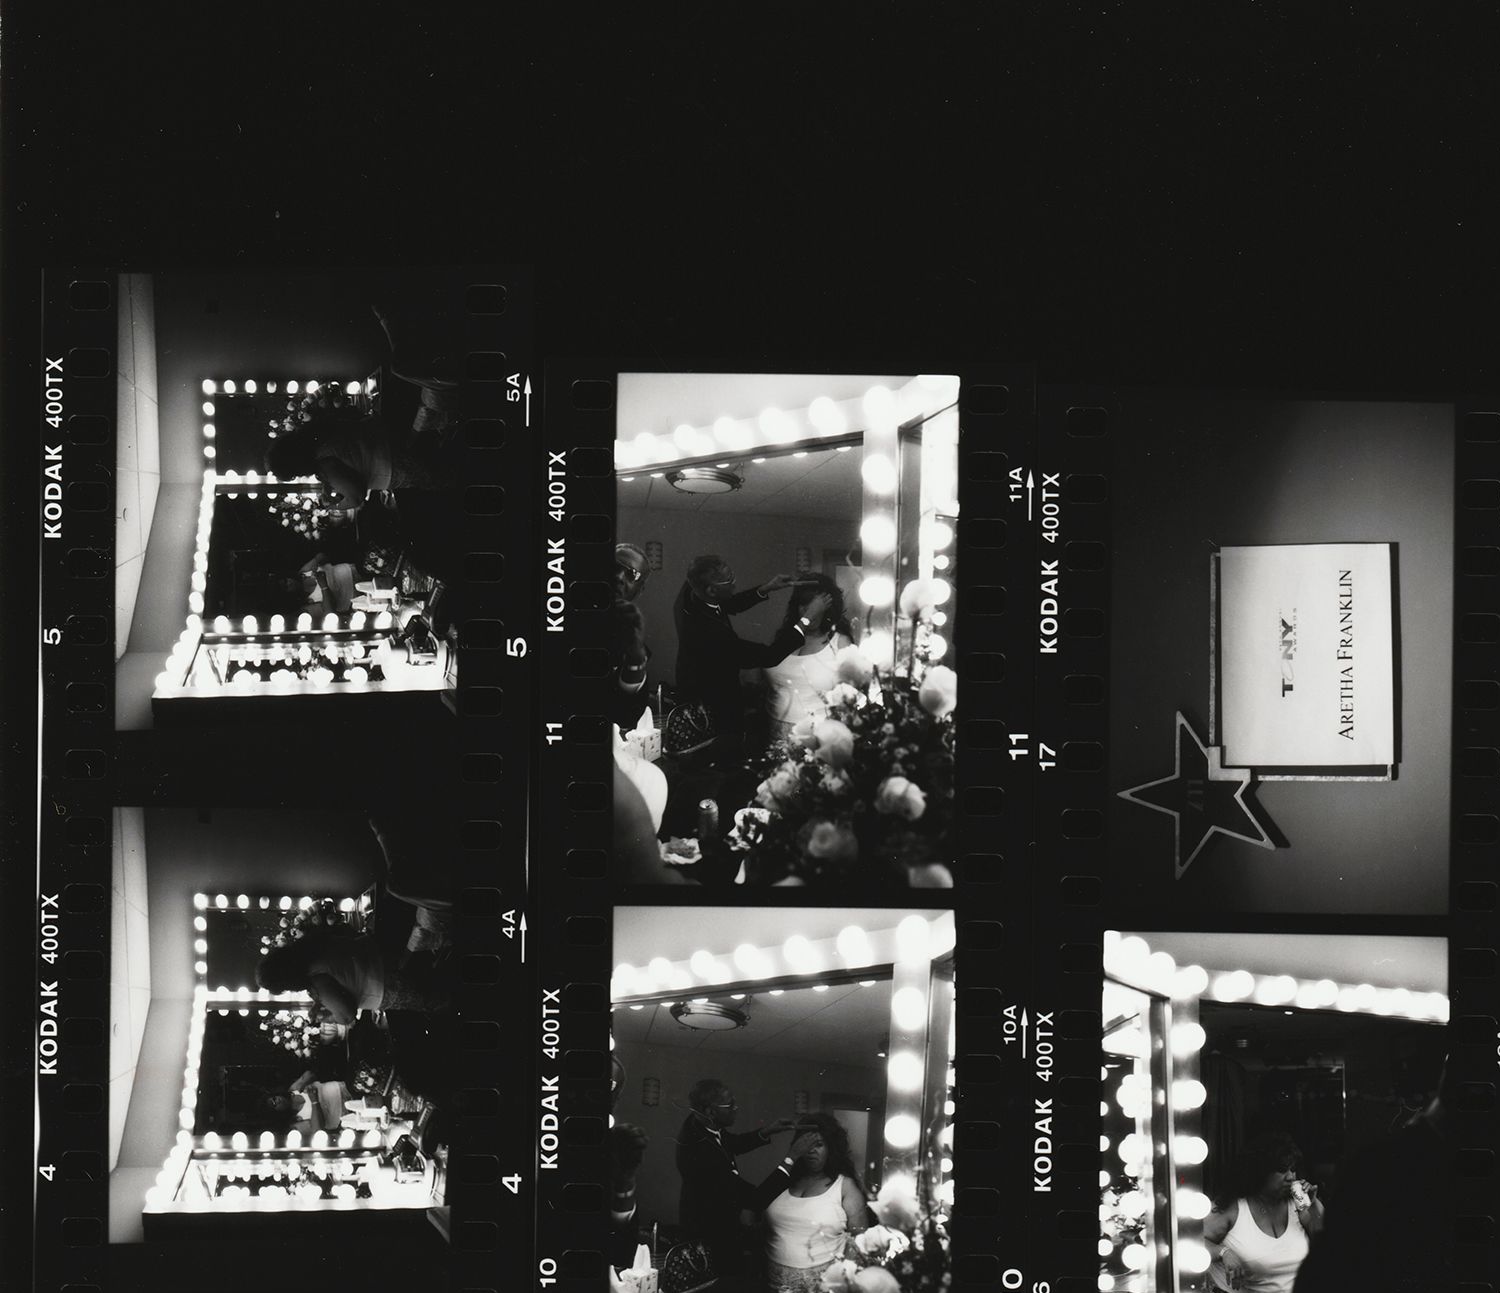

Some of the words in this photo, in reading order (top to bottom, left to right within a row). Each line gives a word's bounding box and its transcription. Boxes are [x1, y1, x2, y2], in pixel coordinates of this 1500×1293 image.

[46, 358, 63, 428] 400TX
[507, 373, 520, 401] 5A
[44, 445, 62, 538] KODAK
[549, 452, 566, 521] 400TX
[1009, 467, 1022, 502] 11A
[1042, 473, 1059, 543] 400TX
[547, 539, 565, 631] KODAK
[1040, 560, 1058, 653] KODAK
[1337, 569, 1354, 661] FRANKLIN
[44, 628, 61, 645] 5
[507, 638, 526, 657] 5
[1338, 667, 1354, 741] ARETHA
[1009, 734, 1028, 760] 11
[1039, 743, 1055, 771] 17
[502, 910, 515, 938] 4A
[1003, 1005, 1016, 1044] 10A
[39, 1164, 56, 1181] 4
[540, 1259, 556, 1287] 10
